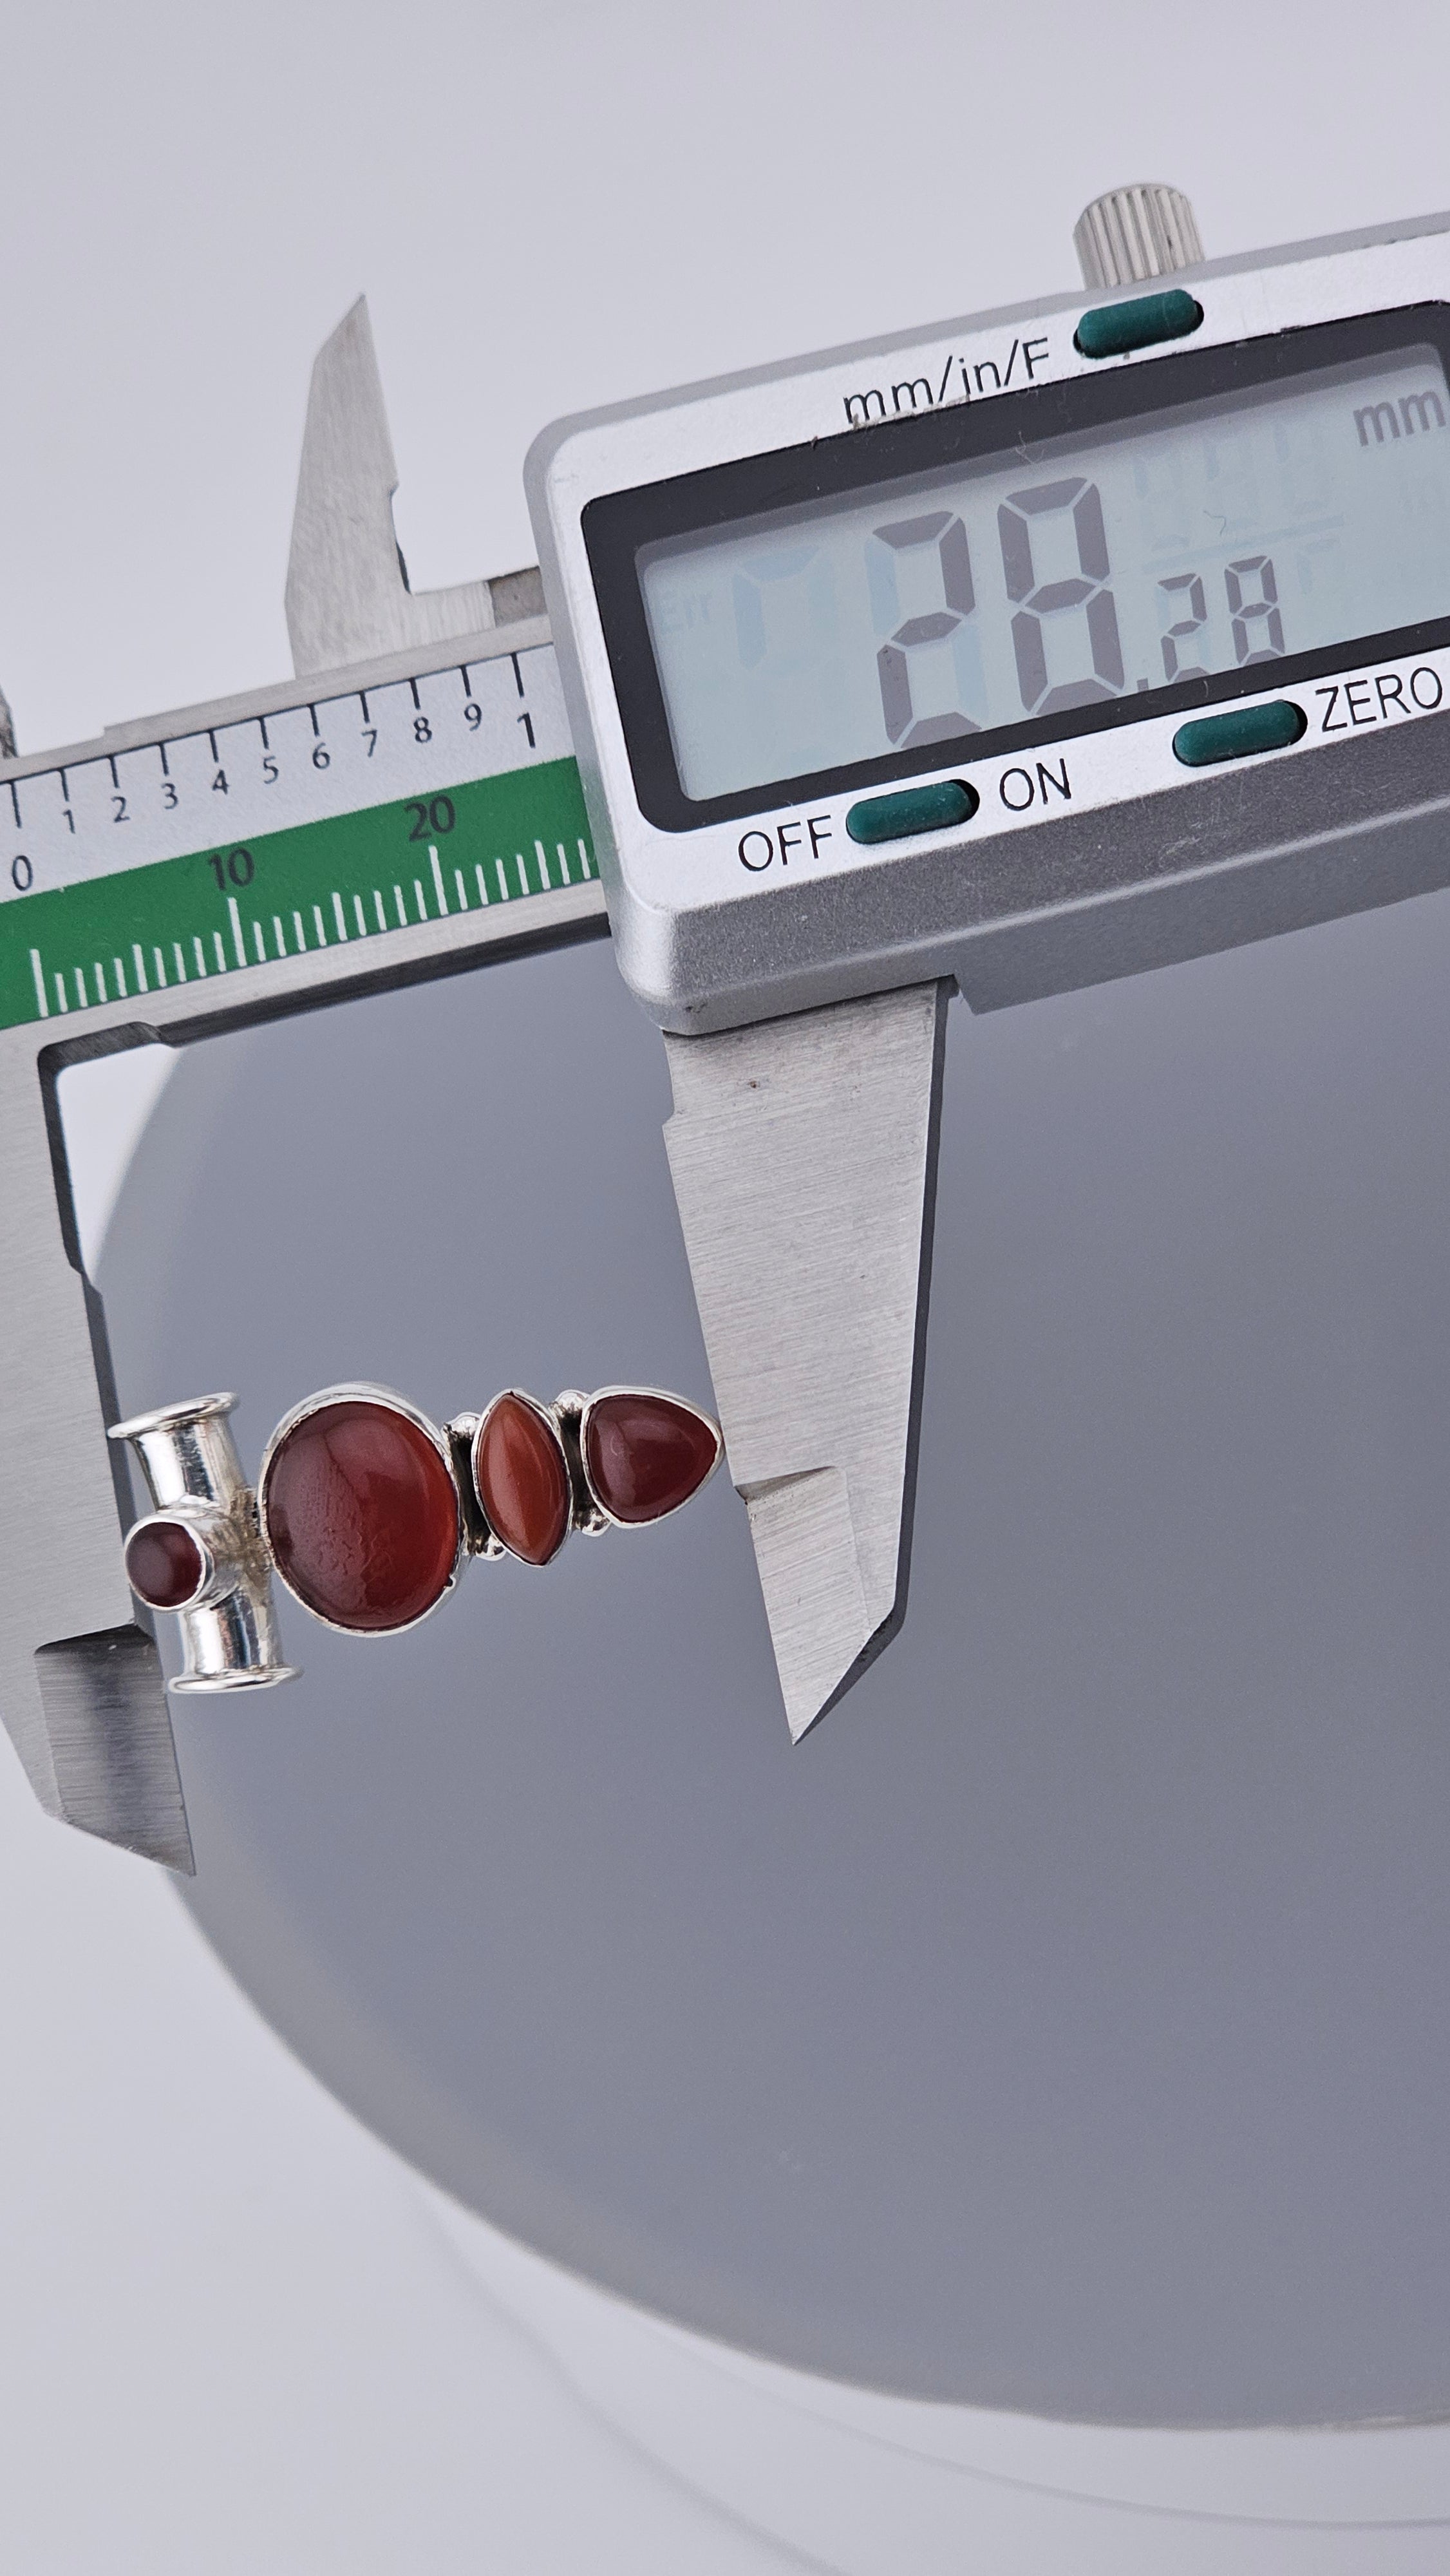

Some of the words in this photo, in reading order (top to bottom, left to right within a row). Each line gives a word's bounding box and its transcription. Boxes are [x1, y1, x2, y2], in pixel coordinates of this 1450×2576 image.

[843, 337, 1049, 424] mm/in/F
[1353, 389, 1447, 447] mm
[872, 477, 1286, 748] 28.28
[1315, 667, 1443, 733] ZERO
[11, 855, 33, 891] 0
[62, 809, 76, 834] 1
[111, 796, 130, 823] 2
[161, 782, 178, 810] 3
[211, 769, 230, 795] 4
[263, 755, 279, 784] 5
[312, 742, 330, 770] 6
[361, 728, 378, 757] 7
[413, 716, 433, 744] 8
[464, 703, 482, 731] 9
[517, 712, 536, 748] 1
[999, 758, 1072, 811] ON
[209, 848, 255, 890] 10
[405, 795, 456, 841] 20
[738, 815, 833, 872] OFF
